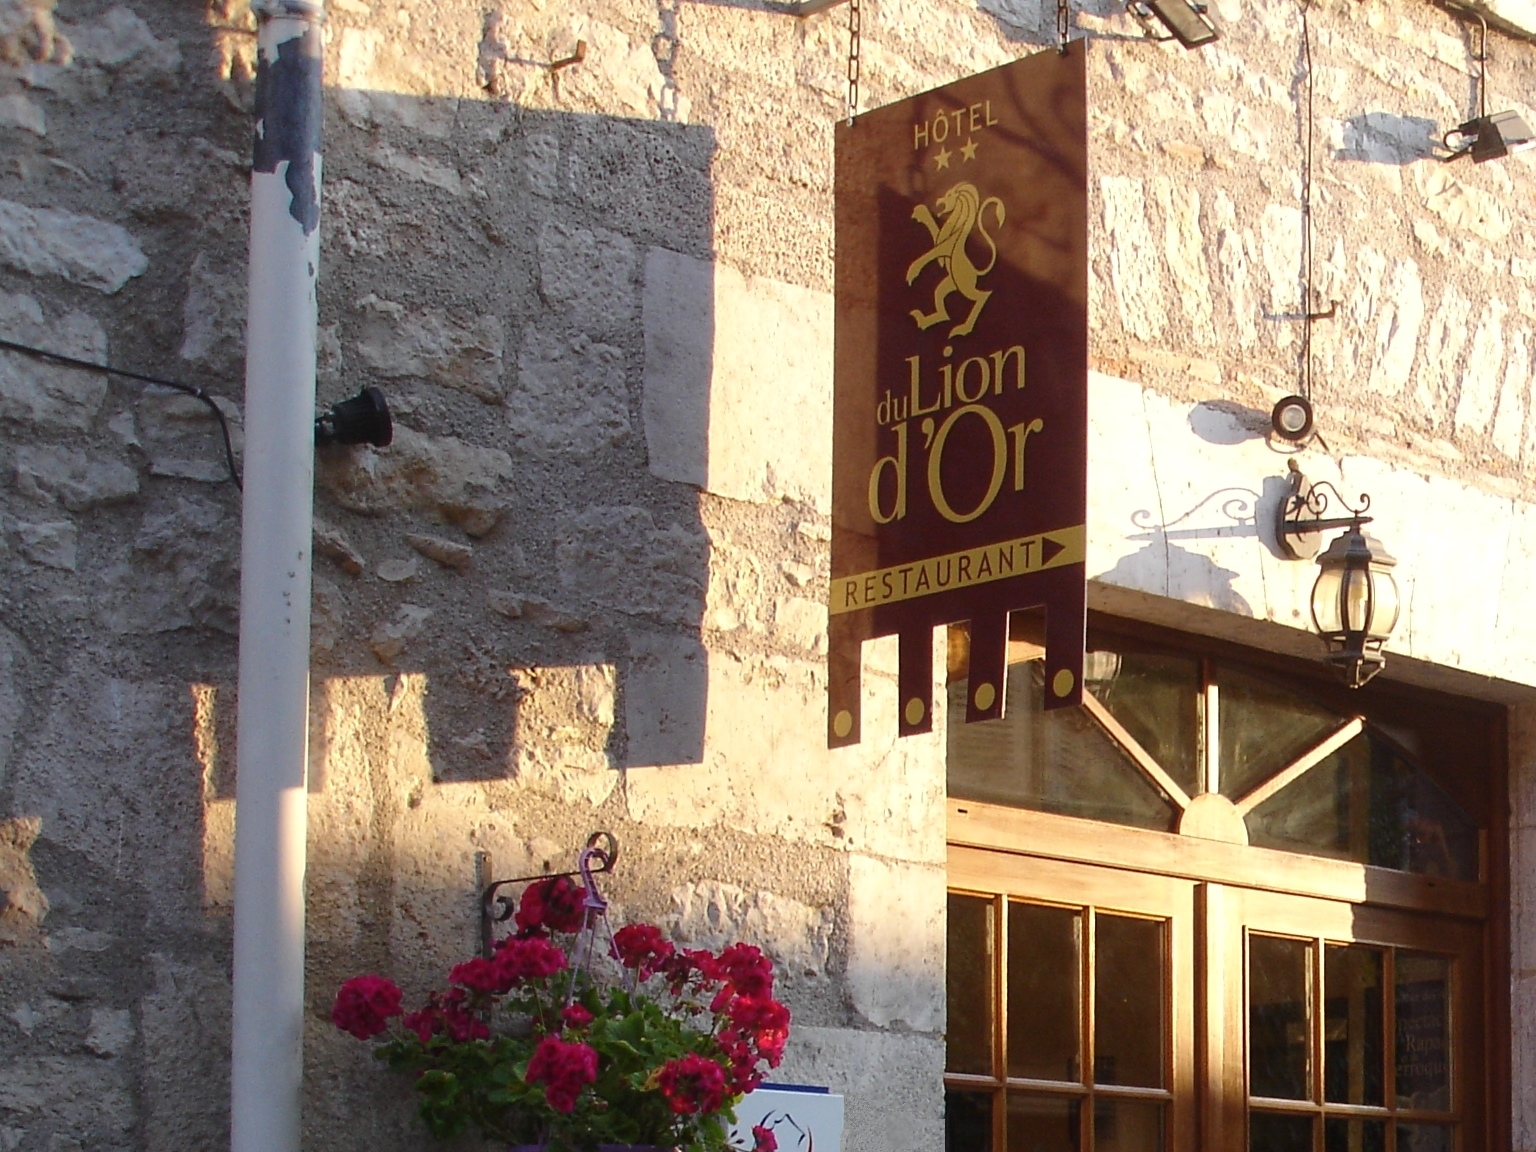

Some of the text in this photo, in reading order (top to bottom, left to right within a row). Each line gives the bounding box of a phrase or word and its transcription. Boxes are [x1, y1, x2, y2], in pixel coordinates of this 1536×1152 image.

[914, 99, 998, 150] HÔTEL
[876, 344, 1027, 426] du Lion
[844, 539, 1037, 609] RESTAURANT
